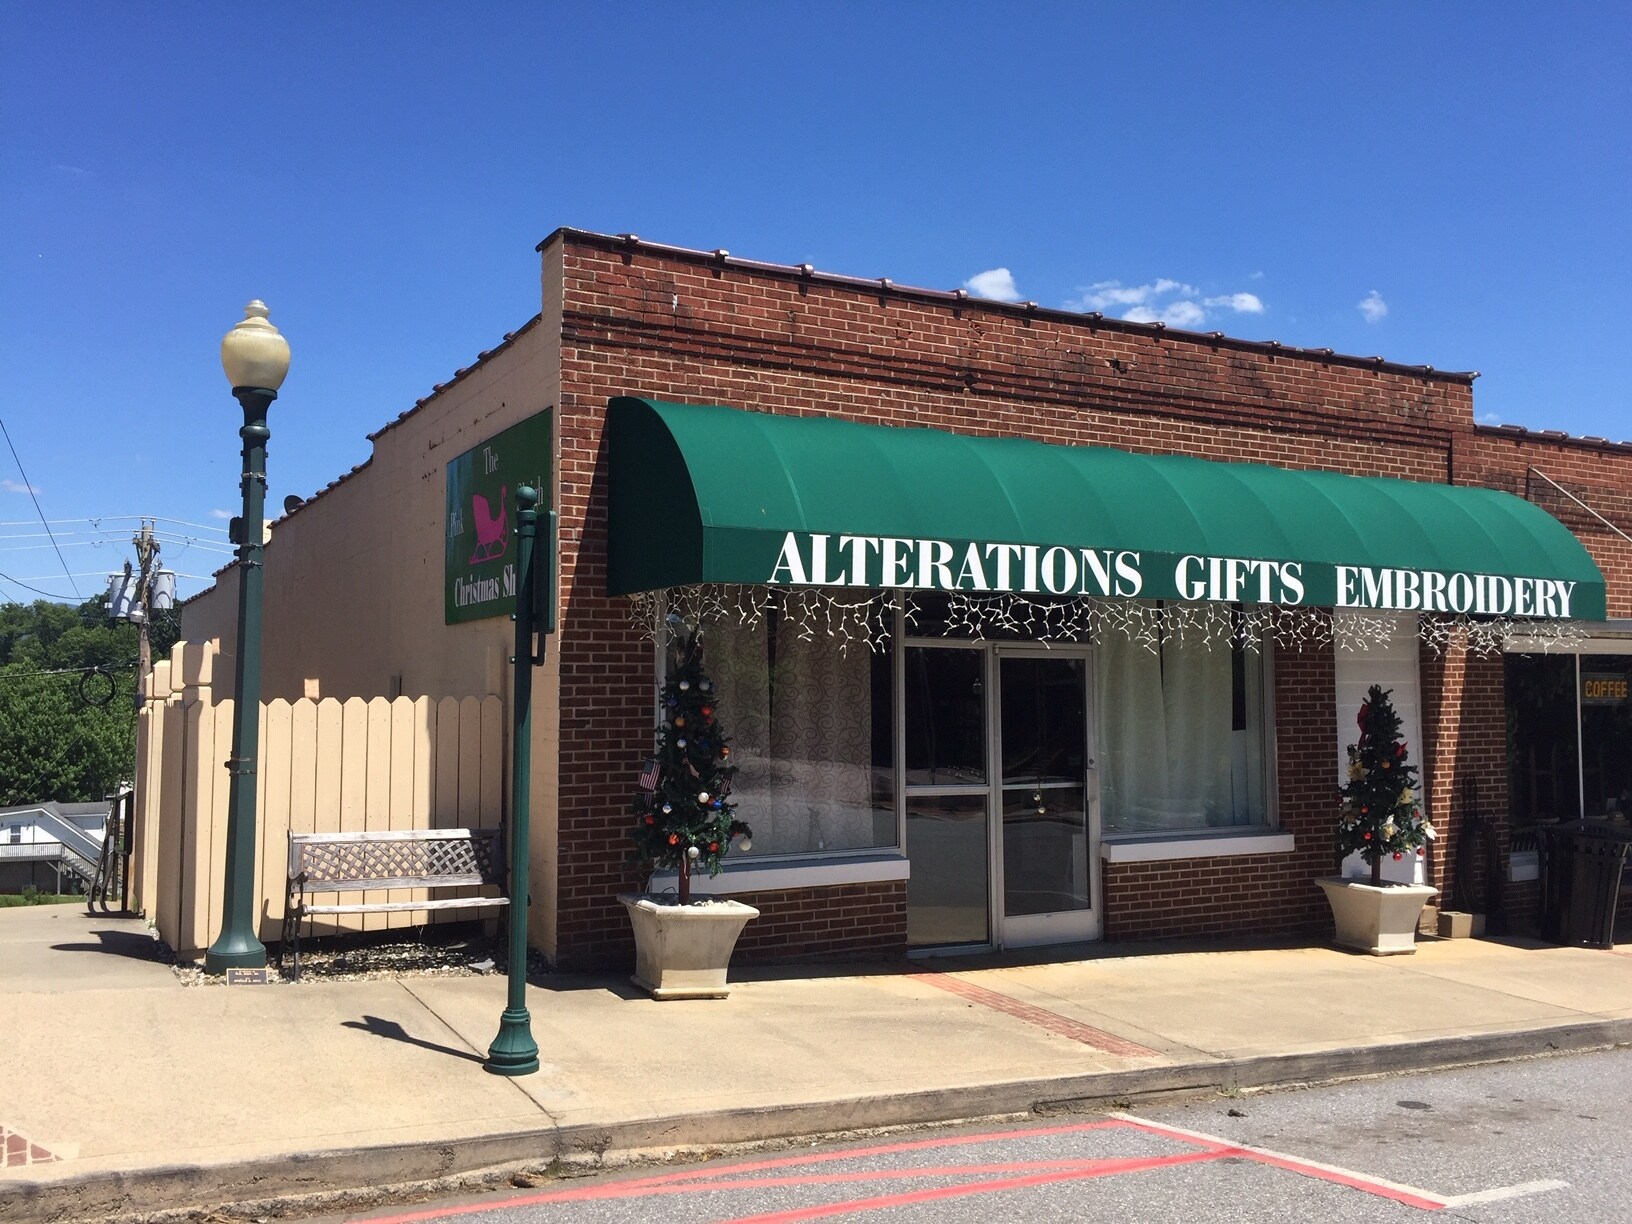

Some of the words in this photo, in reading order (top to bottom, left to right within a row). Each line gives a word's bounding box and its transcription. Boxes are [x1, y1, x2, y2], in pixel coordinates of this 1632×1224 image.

[483, 446, 499, 475] The
[450, 508, 464, 538] Pink
[454, 573, 500, 608] Christmas
[502, 564, 517, 598] Sh
[767, 531, 1143, 597] ALTERATIONS
[1174, 554, 1304, 606] GIFTS
[1334, 565, 1577, 618] EMBROIDERY
[1585, 680, 1628, 698] COFFEE
